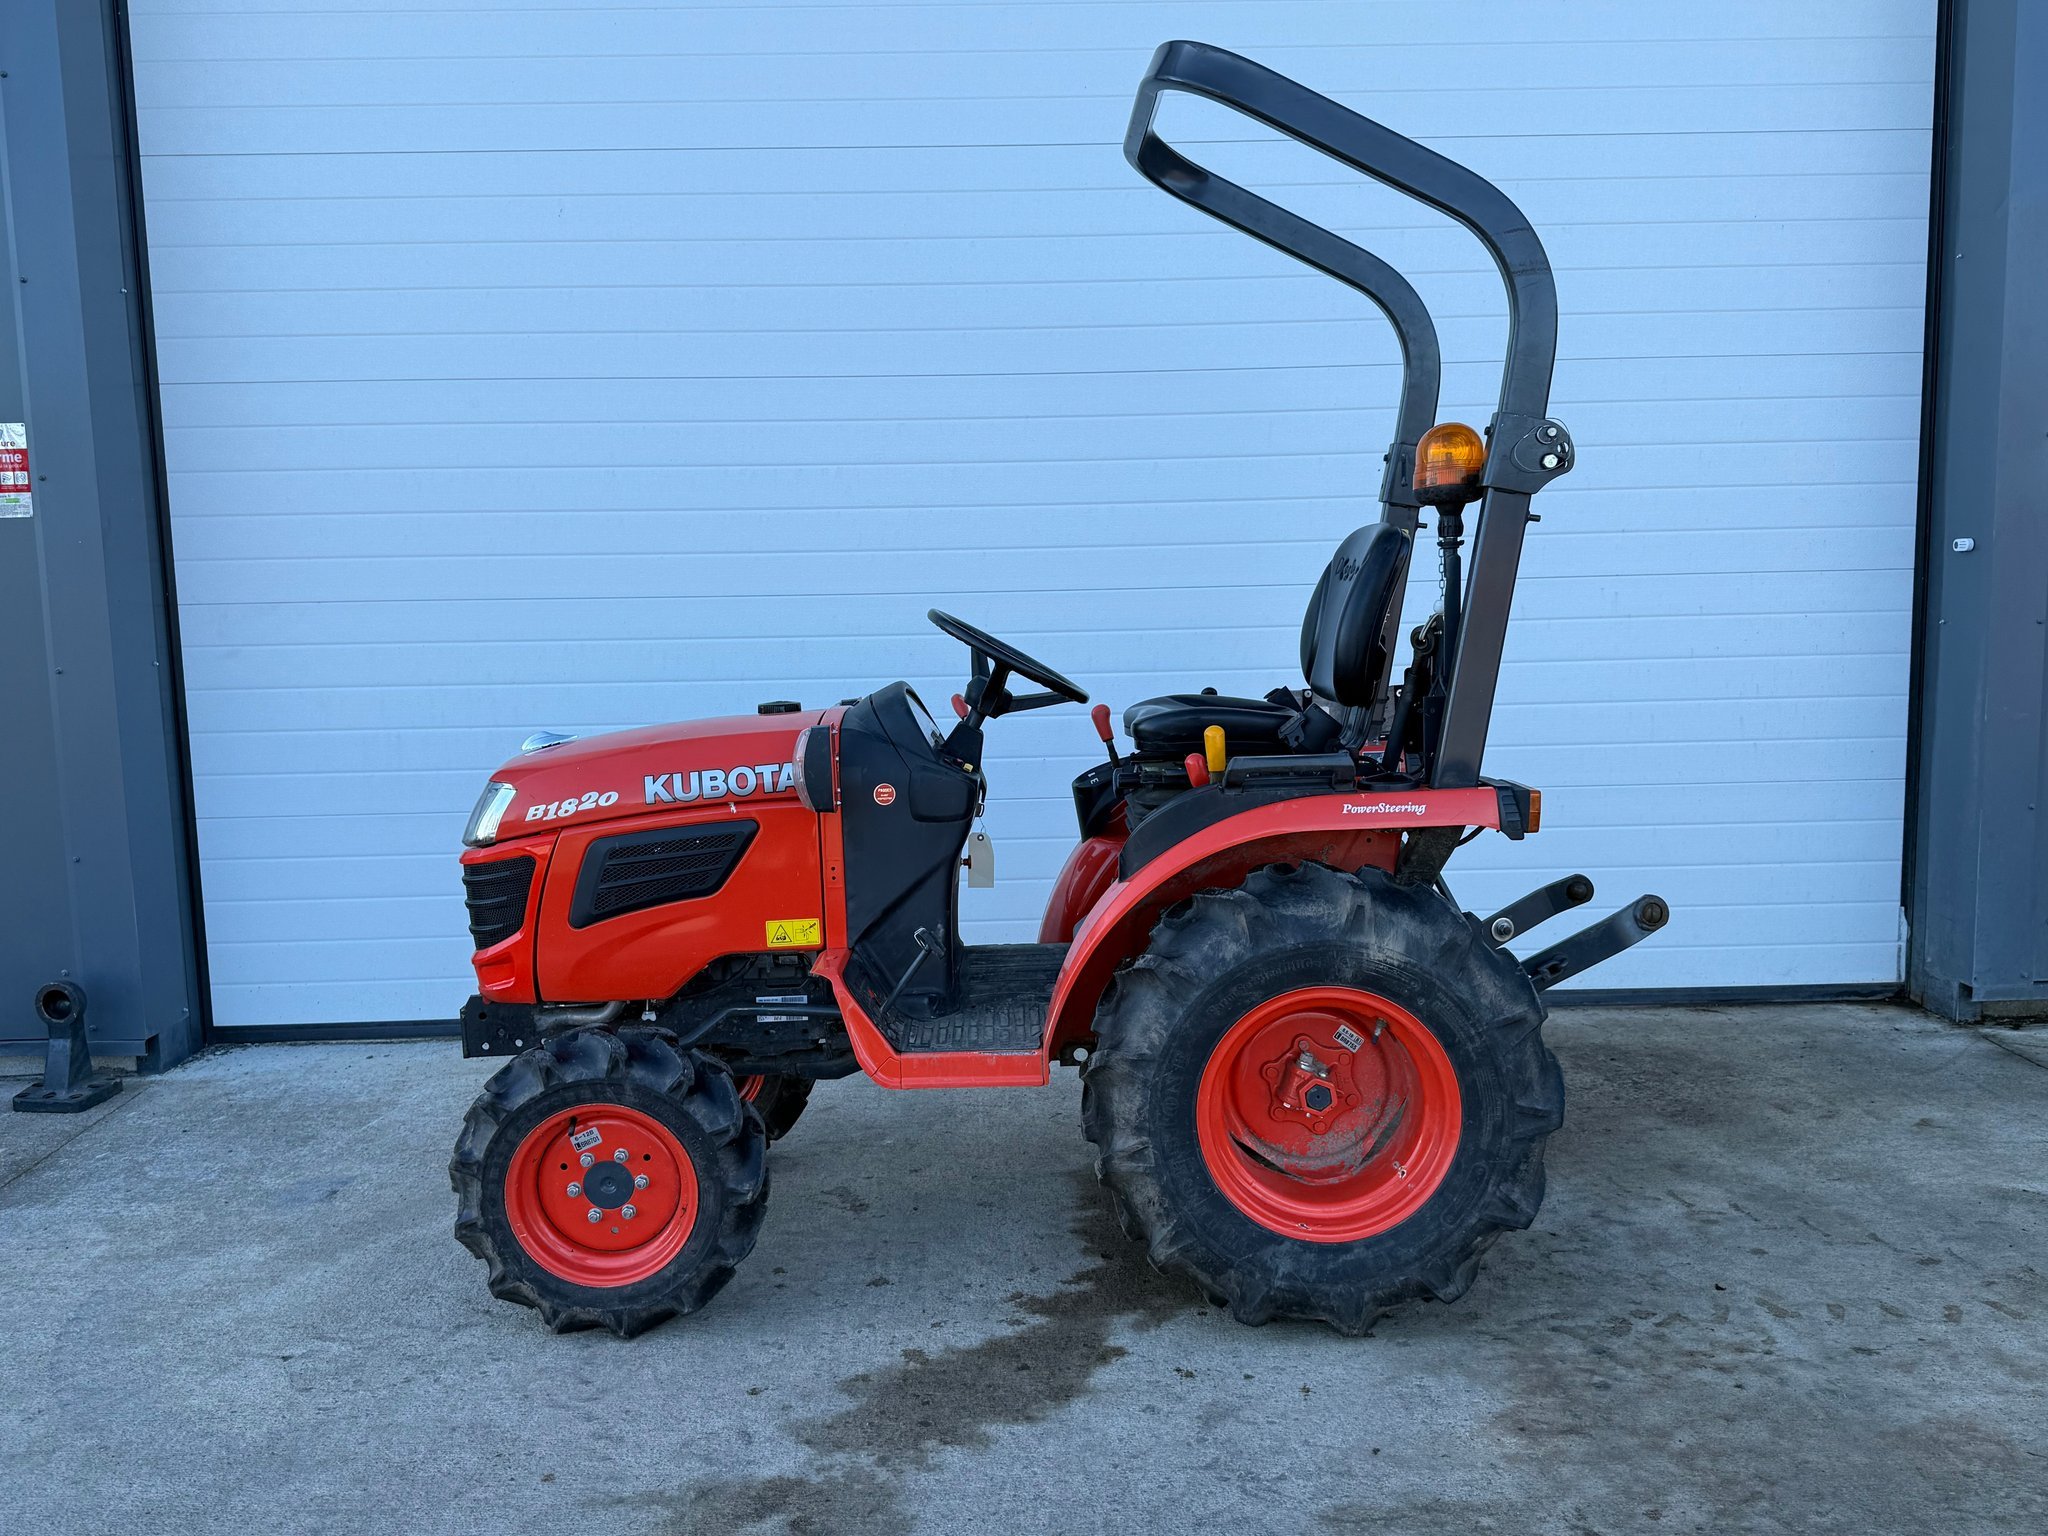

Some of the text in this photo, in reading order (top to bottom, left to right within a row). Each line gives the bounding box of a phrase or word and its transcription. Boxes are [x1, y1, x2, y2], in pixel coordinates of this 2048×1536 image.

[644, 762, 795, 805] KUBOTA
[524, 791, 619, 822] B1820
[1342, 802, 1427, 816] PowerSteering
